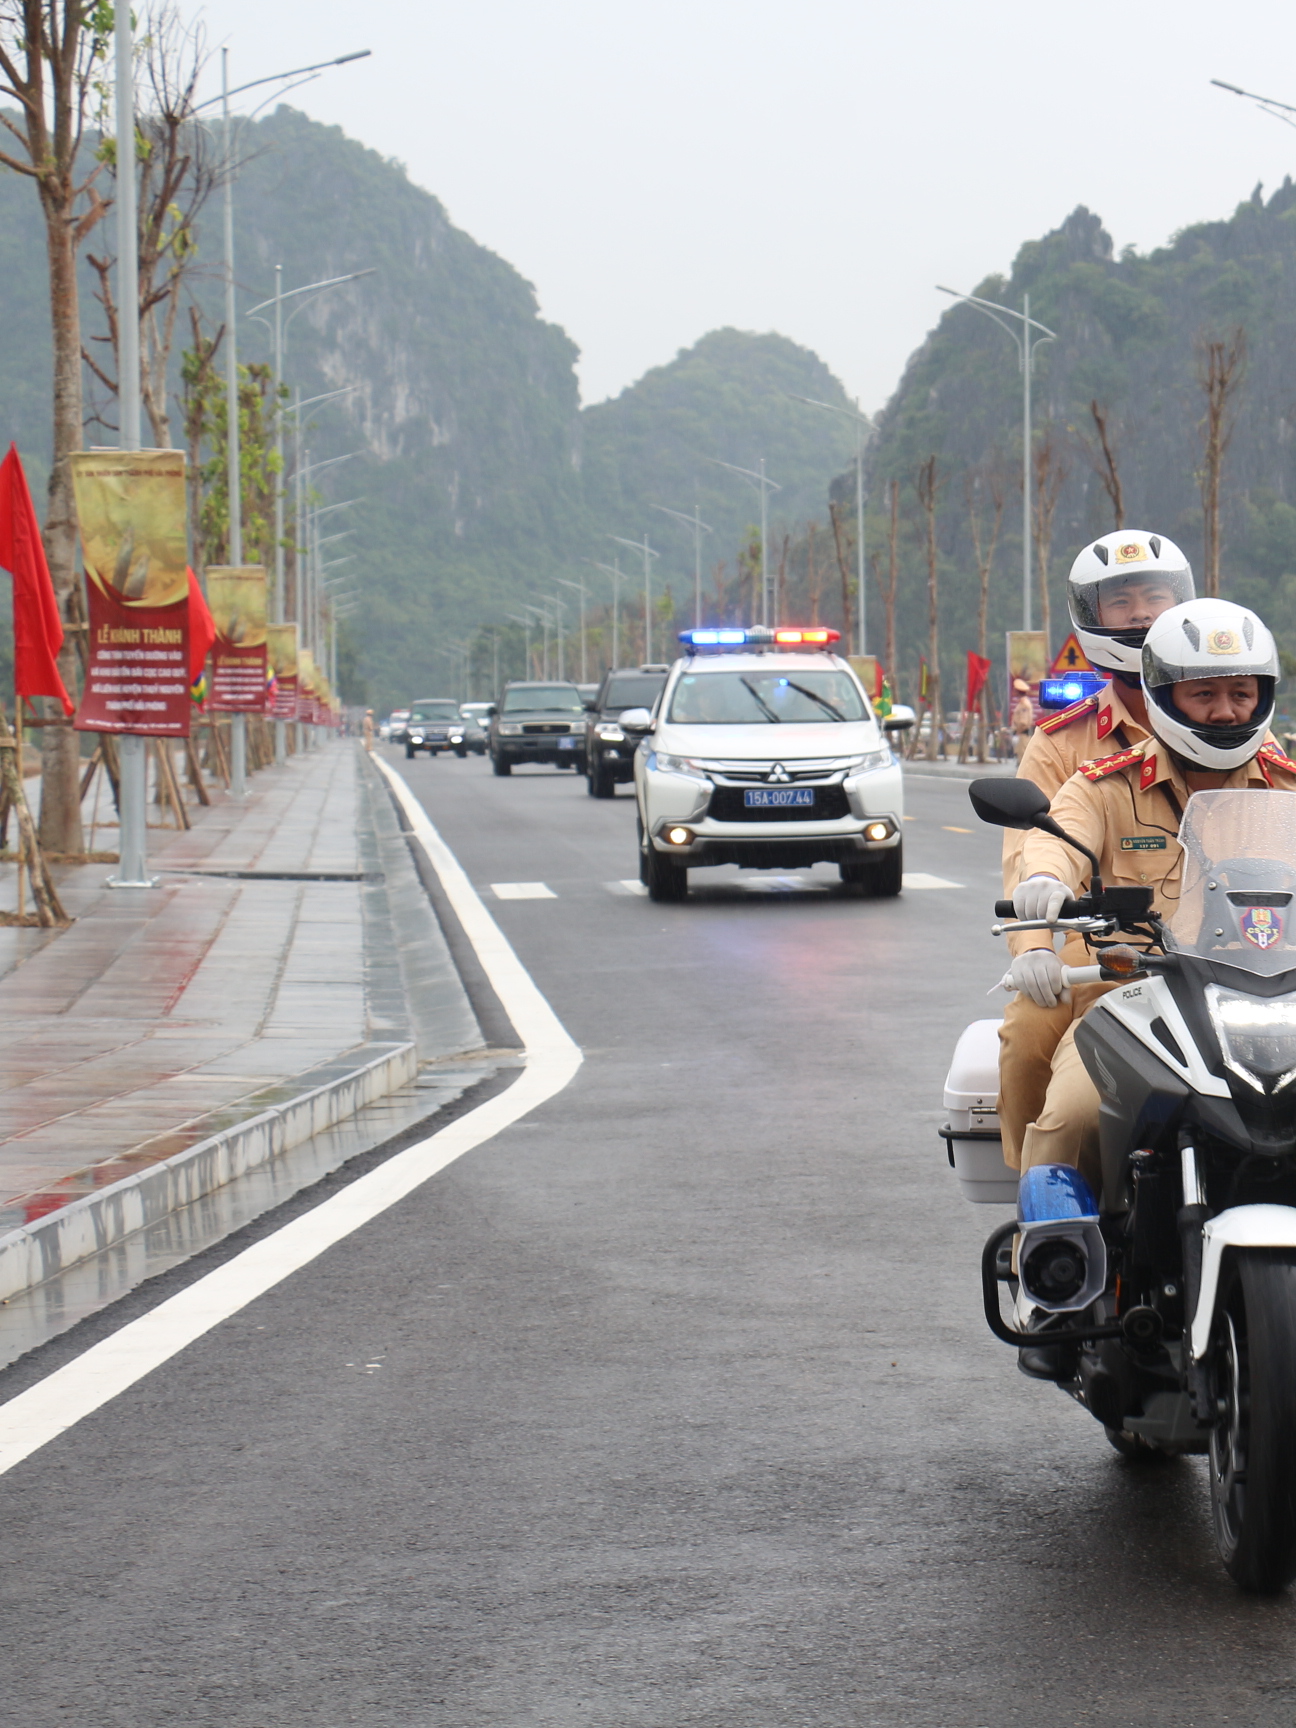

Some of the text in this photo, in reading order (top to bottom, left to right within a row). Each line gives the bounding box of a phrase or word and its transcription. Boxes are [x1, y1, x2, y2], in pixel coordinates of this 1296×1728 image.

[97, 623, 109, 644] LỄ
[142, 625, 183, 644] THÀNH
[1122, 986, 1142, 1000] POLICE
